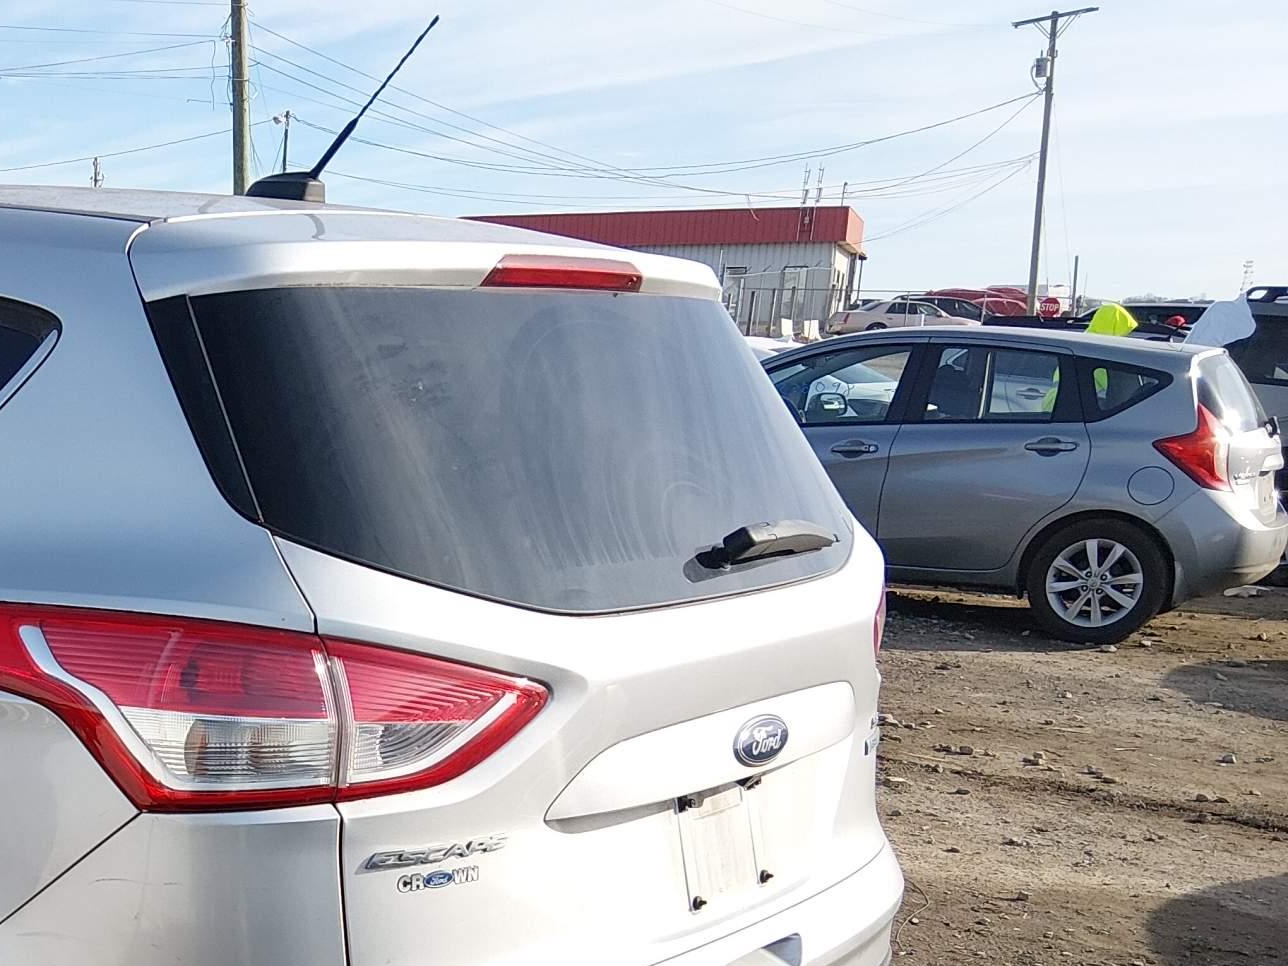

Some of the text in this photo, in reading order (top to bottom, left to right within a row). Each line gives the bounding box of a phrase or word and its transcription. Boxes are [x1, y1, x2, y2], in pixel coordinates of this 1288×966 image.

[1040, 303, 1060, 312] STOP
[750, 725, 783, 756] Ford
[362, 832, 509, 870] ESCAPE
